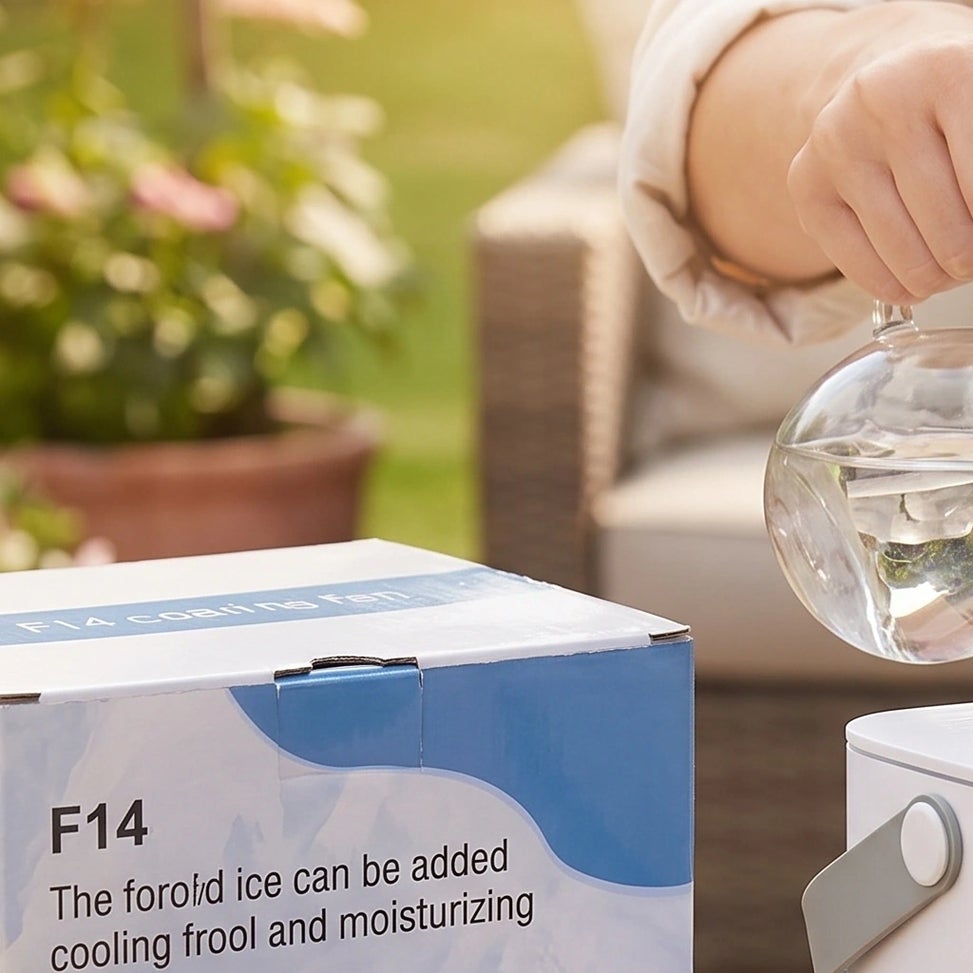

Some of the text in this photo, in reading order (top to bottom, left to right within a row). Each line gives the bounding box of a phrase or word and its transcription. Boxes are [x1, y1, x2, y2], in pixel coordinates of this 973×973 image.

[16, 616, 116, 633] F14
[51, 799, 148, 854] F14
[50, 885, 112, 920] The
[237, 867, 281, 901] ice
[293, 866, 349, 895] can
[362, 854, 400, 888] be
[411, 838, 508, 882] added
[51, 889, 534, 971] cooling frool and moisturizing
